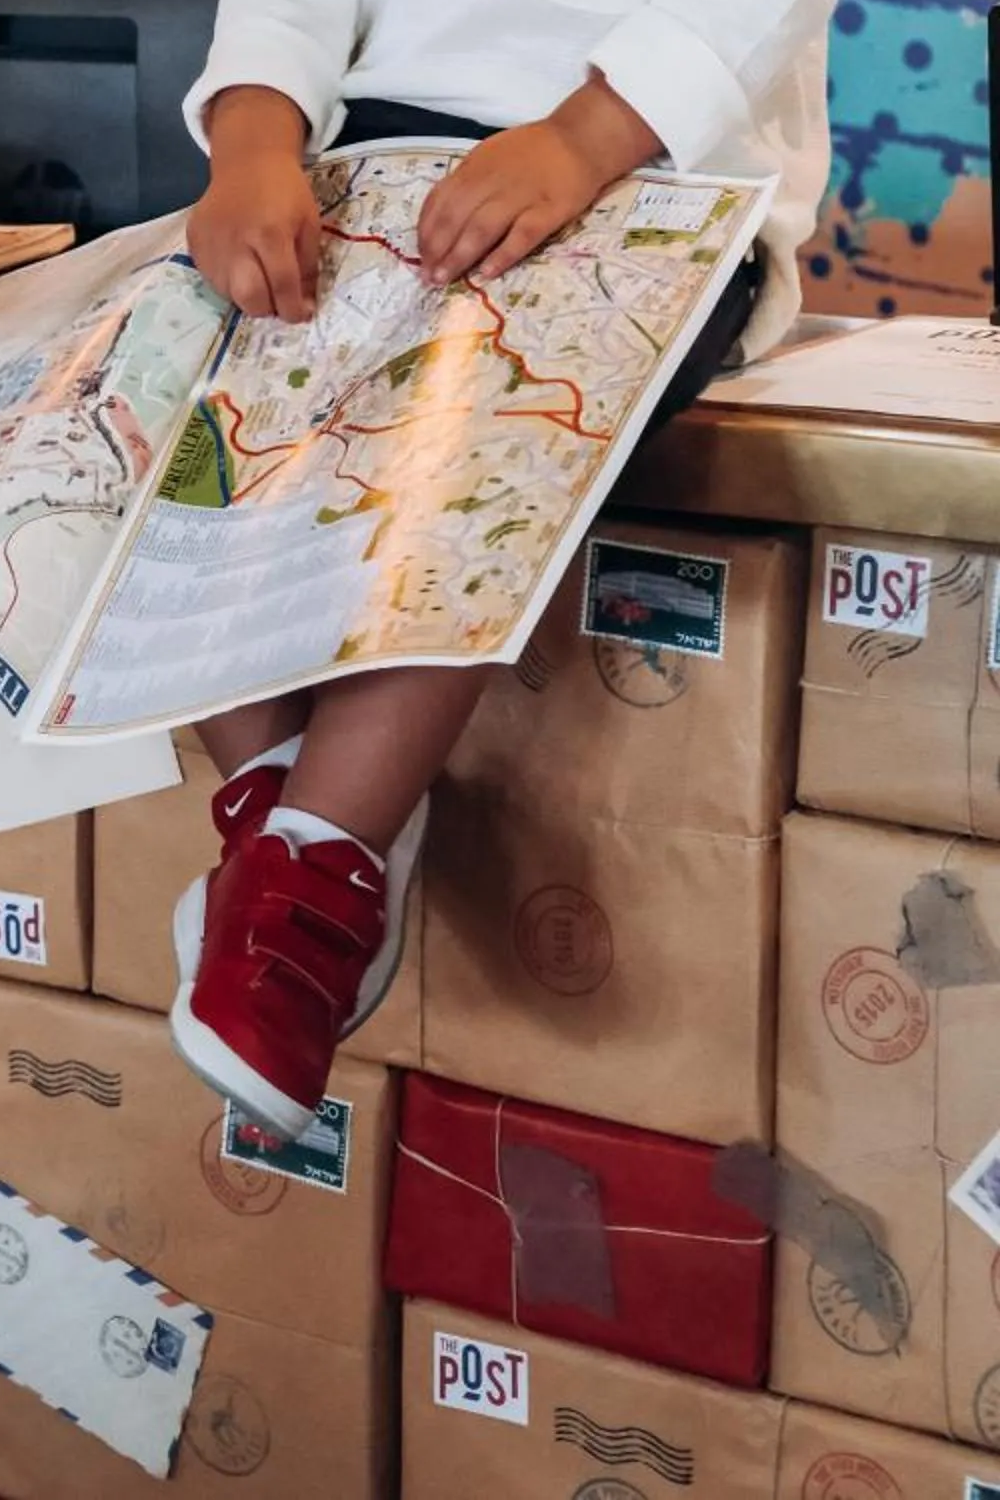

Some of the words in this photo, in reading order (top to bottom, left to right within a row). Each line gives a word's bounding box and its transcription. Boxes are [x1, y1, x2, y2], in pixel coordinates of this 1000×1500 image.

[832, 549, 854, 567] THE
[676, 561, 714, 581] 200
[828, 554, 926, 621] POST
[440, 1336, 459, 1354] THE
[439, 1344, 525, 1406] POST
